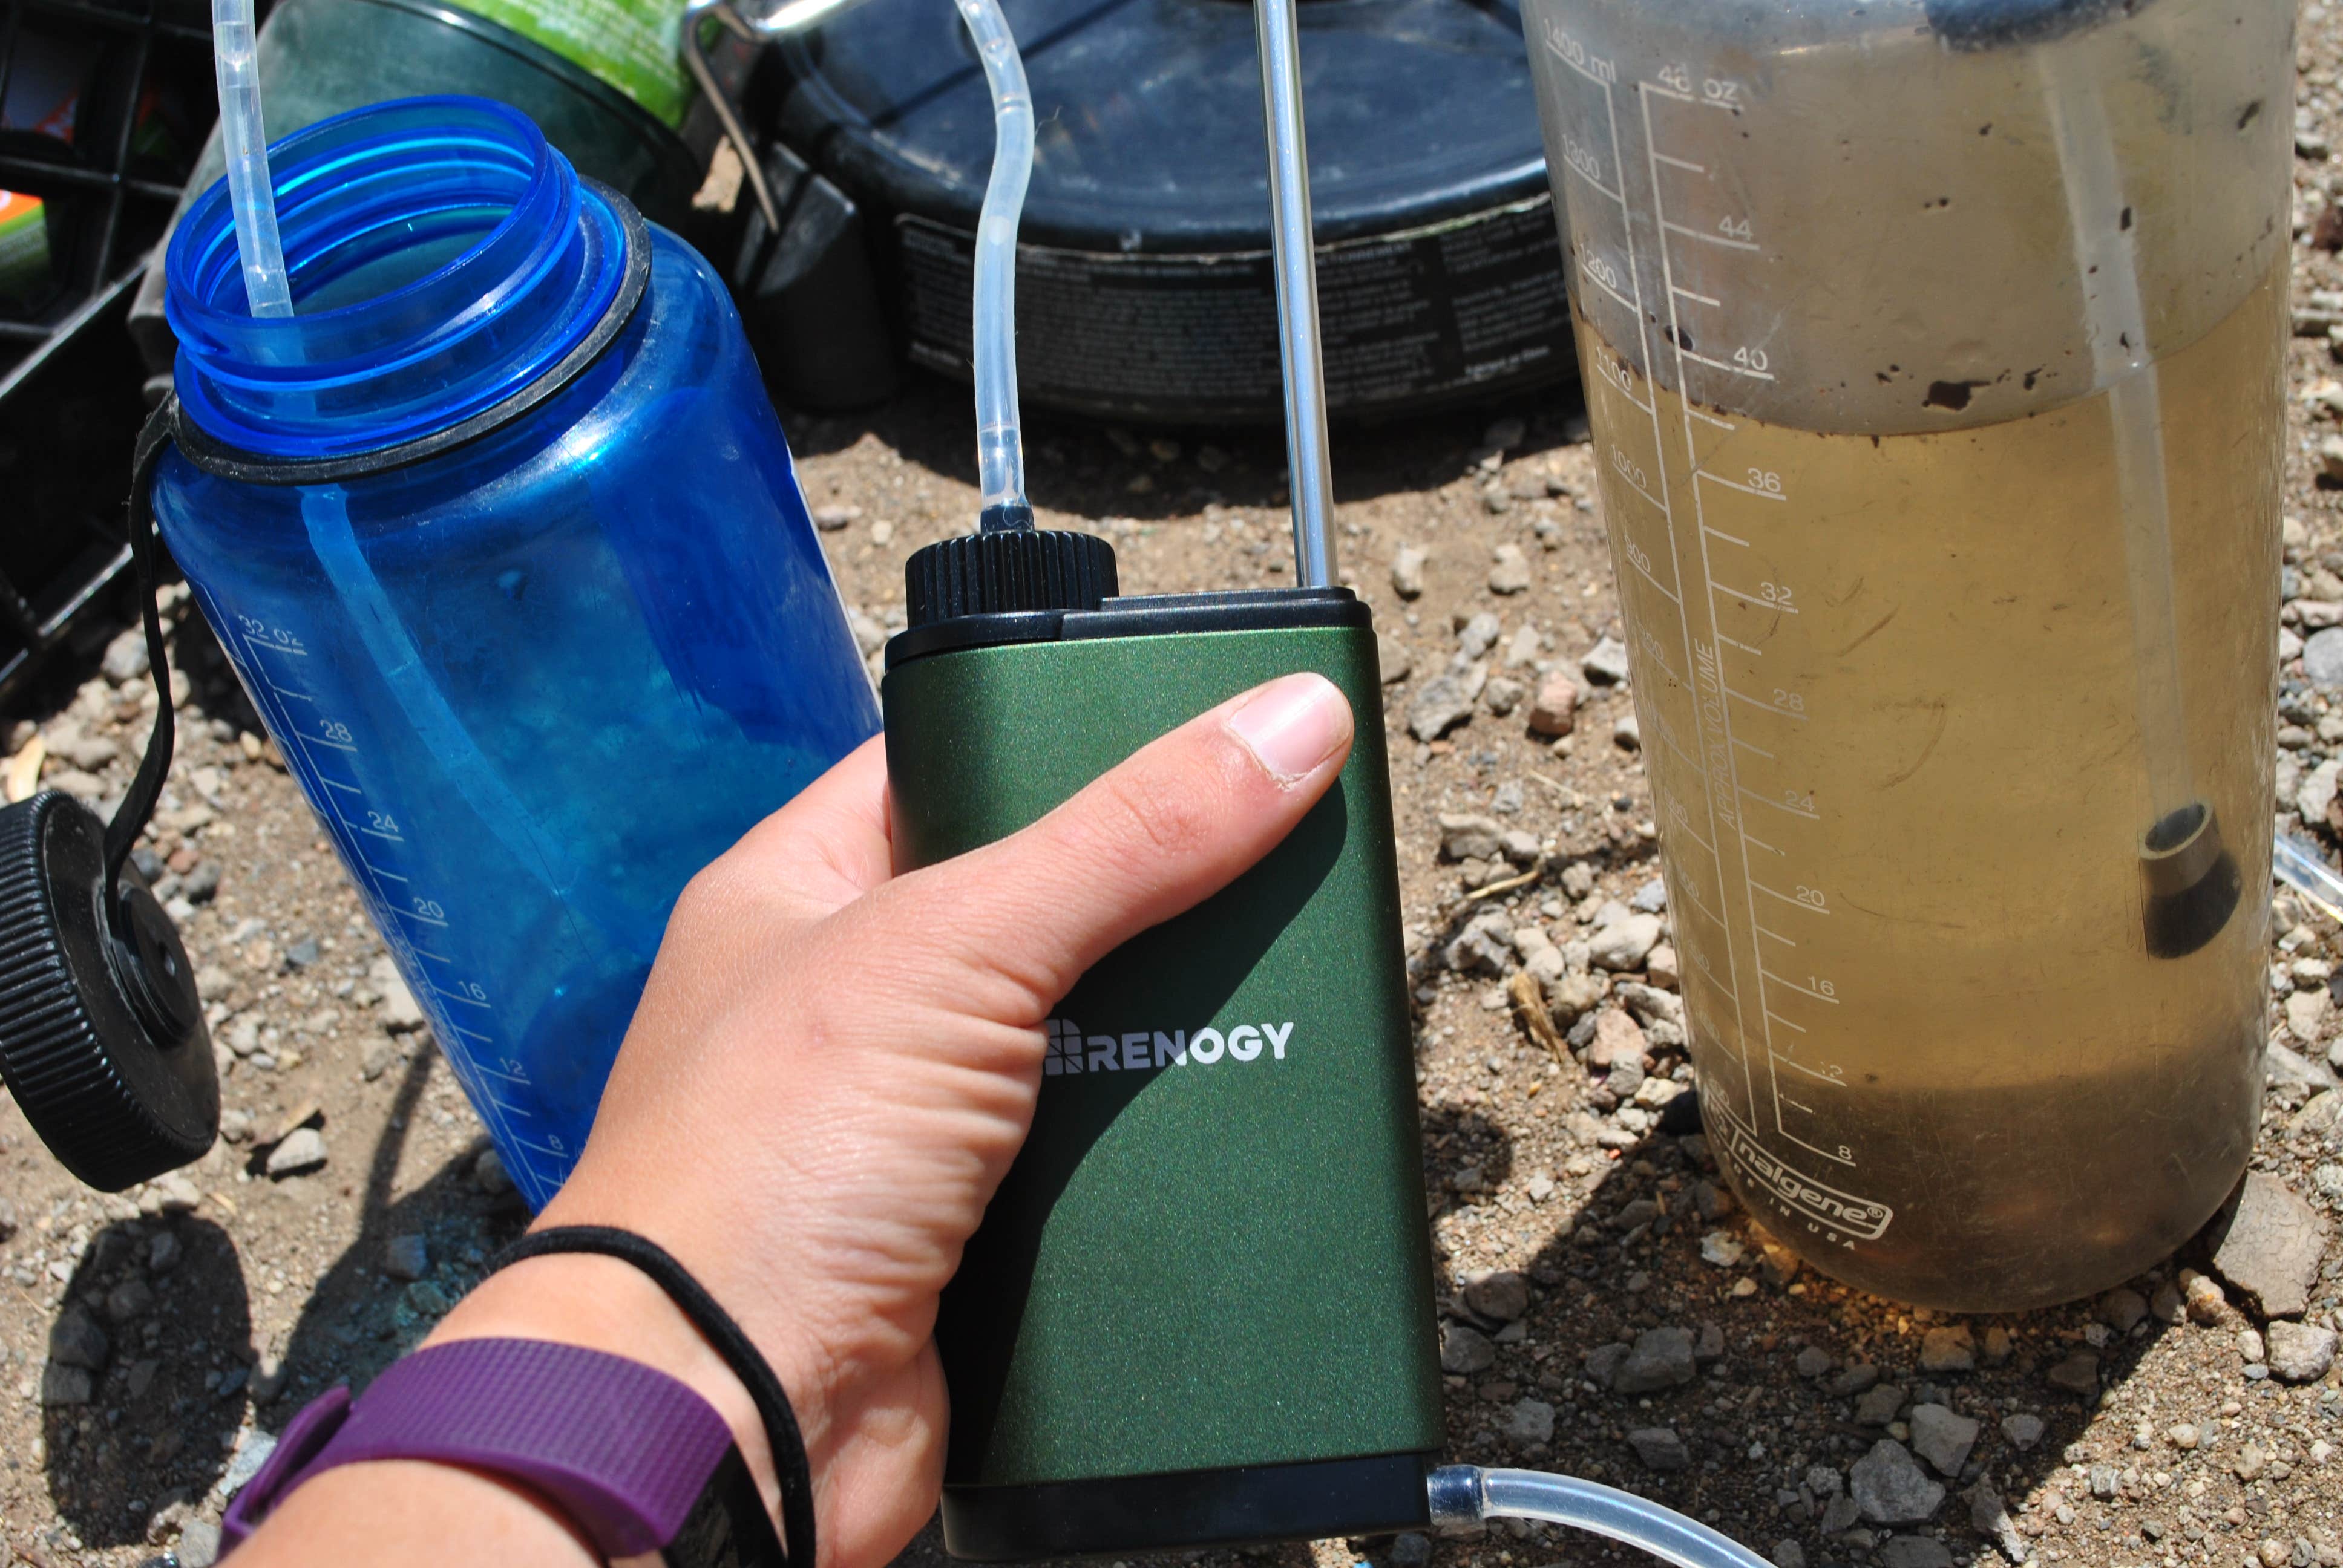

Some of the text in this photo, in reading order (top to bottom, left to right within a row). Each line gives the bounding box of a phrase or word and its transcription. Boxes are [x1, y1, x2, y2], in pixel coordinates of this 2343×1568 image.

[1718, 215, 1753, 240] 44
[1580, 244, 1617, 289] 1200
[1596, 346, 1631, 390] 1100
[1734, 346, 1768, 371] 40
[1747, 468, 1781, 493] 36
[1760, 581, 1792, 606] 32
[238, 614, 269, 640] 32
[1773, 688, 1804, 711] 28
[320, 719, 353, 743] 28
[1785, 790, 1815, 812] 24
[368, 811, 399, 832] 24
[1795, 885, 1826, 906] 20
[413, 897, 445, 918] 20
[458, 980, 487, 1000] 16
[1807, 976, 1835, 996] 16
[1087, 1022, 1294, 1072] RENOGY
[499, 1057, 527, 1076] 12
[548, 1134, 564, 1150] 8
[1838, 1145, 1852, 1160] 8
[1807, 1223, 1856, 1251] USA
